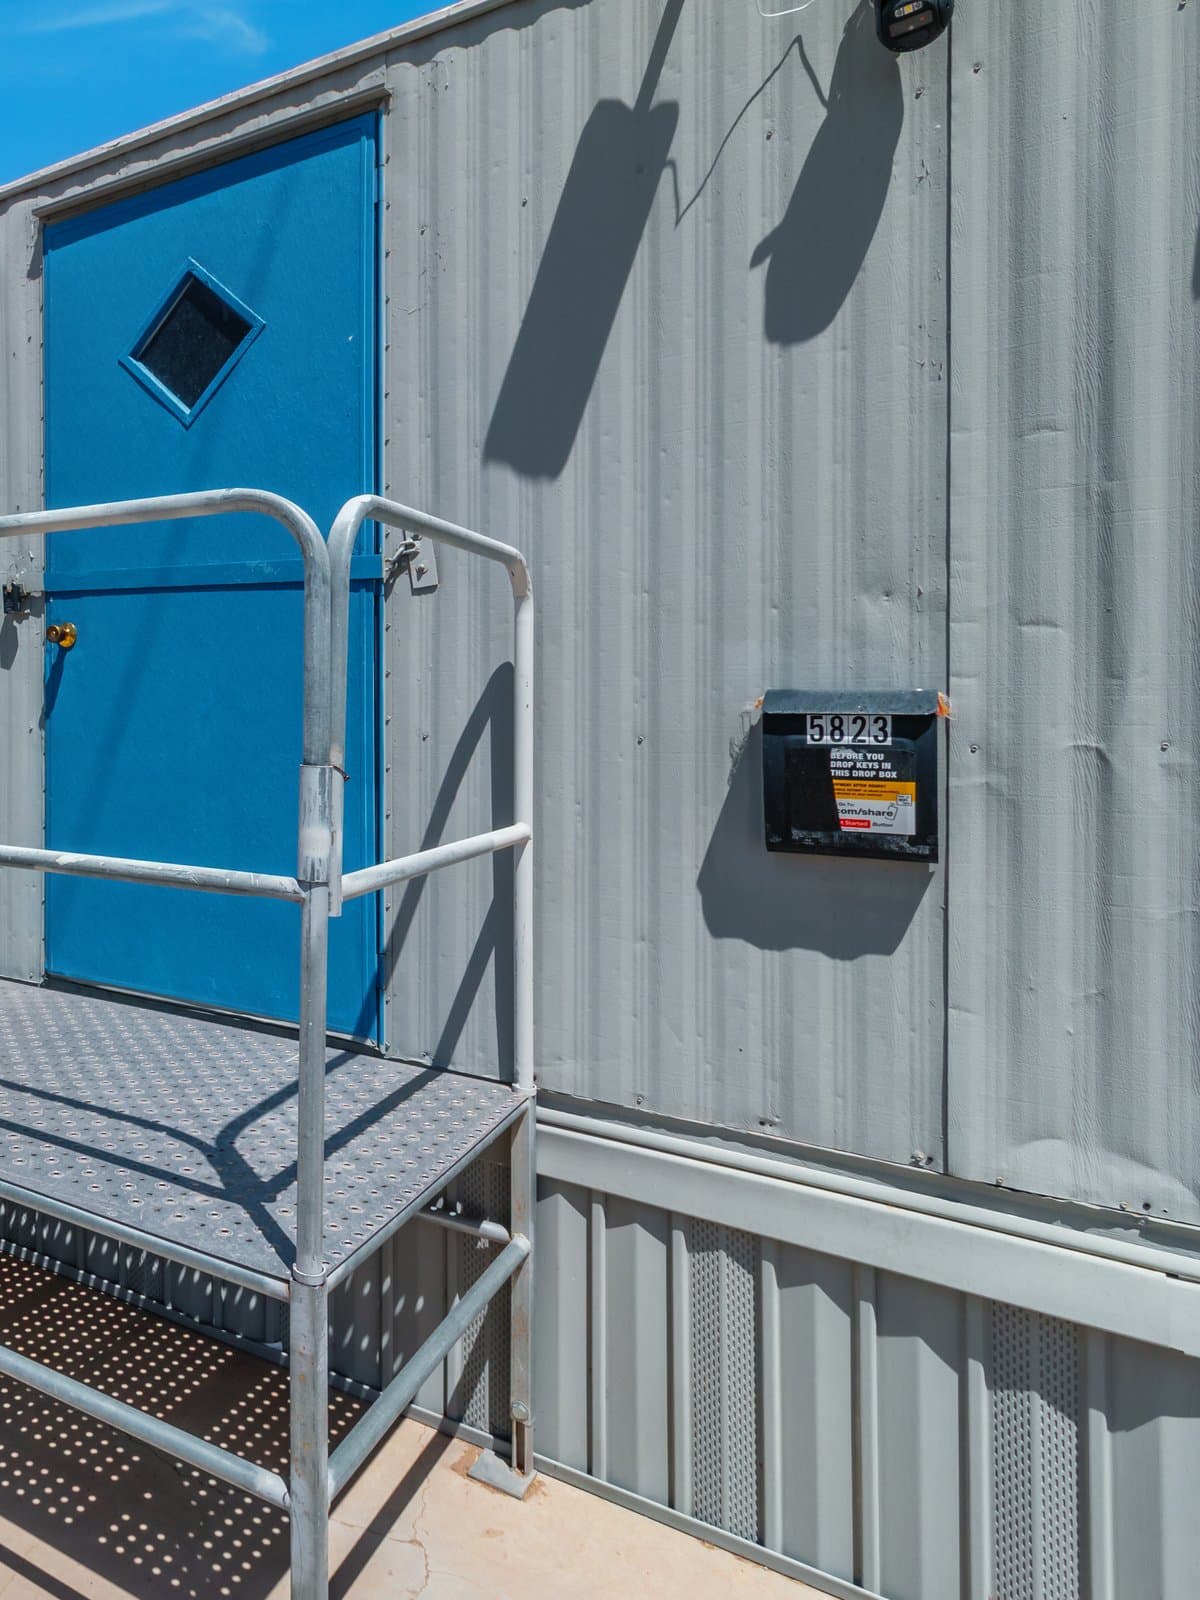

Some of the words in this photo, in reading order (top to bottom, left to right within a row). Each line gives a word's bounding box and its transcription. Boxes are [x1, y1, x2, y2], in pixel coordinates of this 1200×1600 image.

[809, 714, 889, 743] 5823
[830, 752, 864, 760] BEFORE
[856, 761, 879, 769] KEYS
[830, 769, 850, 777] THIS
